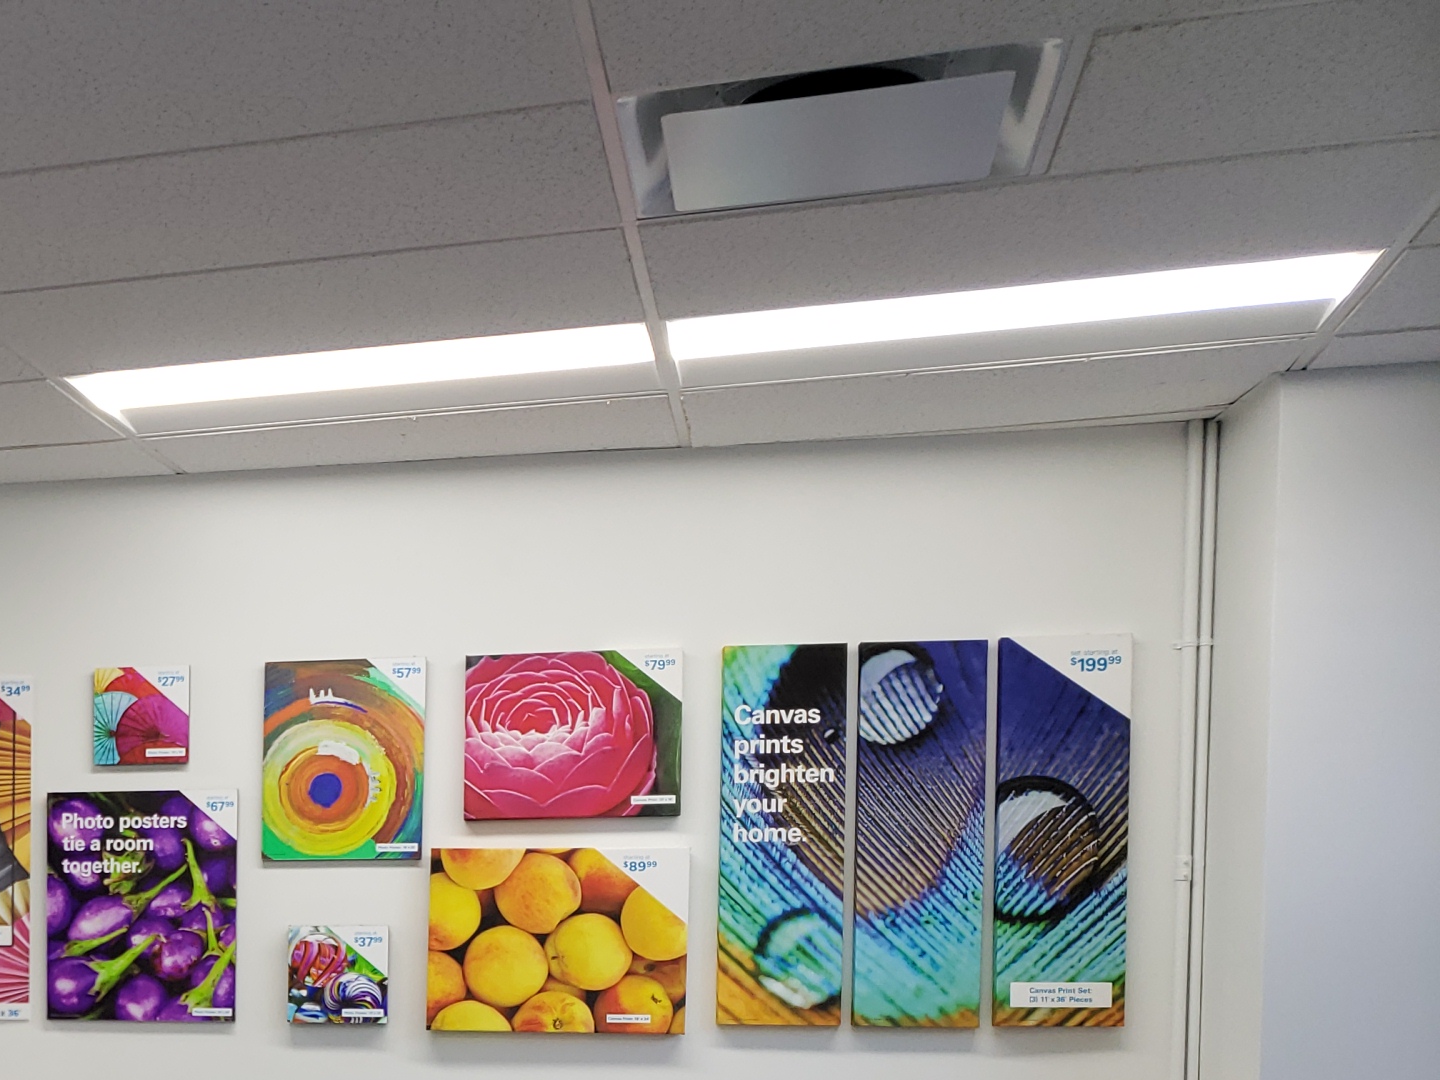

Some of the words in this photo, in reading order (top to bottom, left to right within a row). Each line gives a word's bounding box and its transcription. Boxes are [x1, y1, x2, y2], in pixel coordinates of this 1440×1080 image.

[734, 704, 821, 725] Canvas
[734, 734, 804, 759] prints
[733, 763, 835, 788] brighten
[733, 798, 787, 818] your
[61, 813, 114, 830] Photo
[119, 814, 187, 832] posters
[733, 823, 807, 843] home.
[62, 836, 85, 851] tie
[90, 840, 101, 851] a
[106, 838, 154, 851] room
[62, 858, 142, 875] together.
